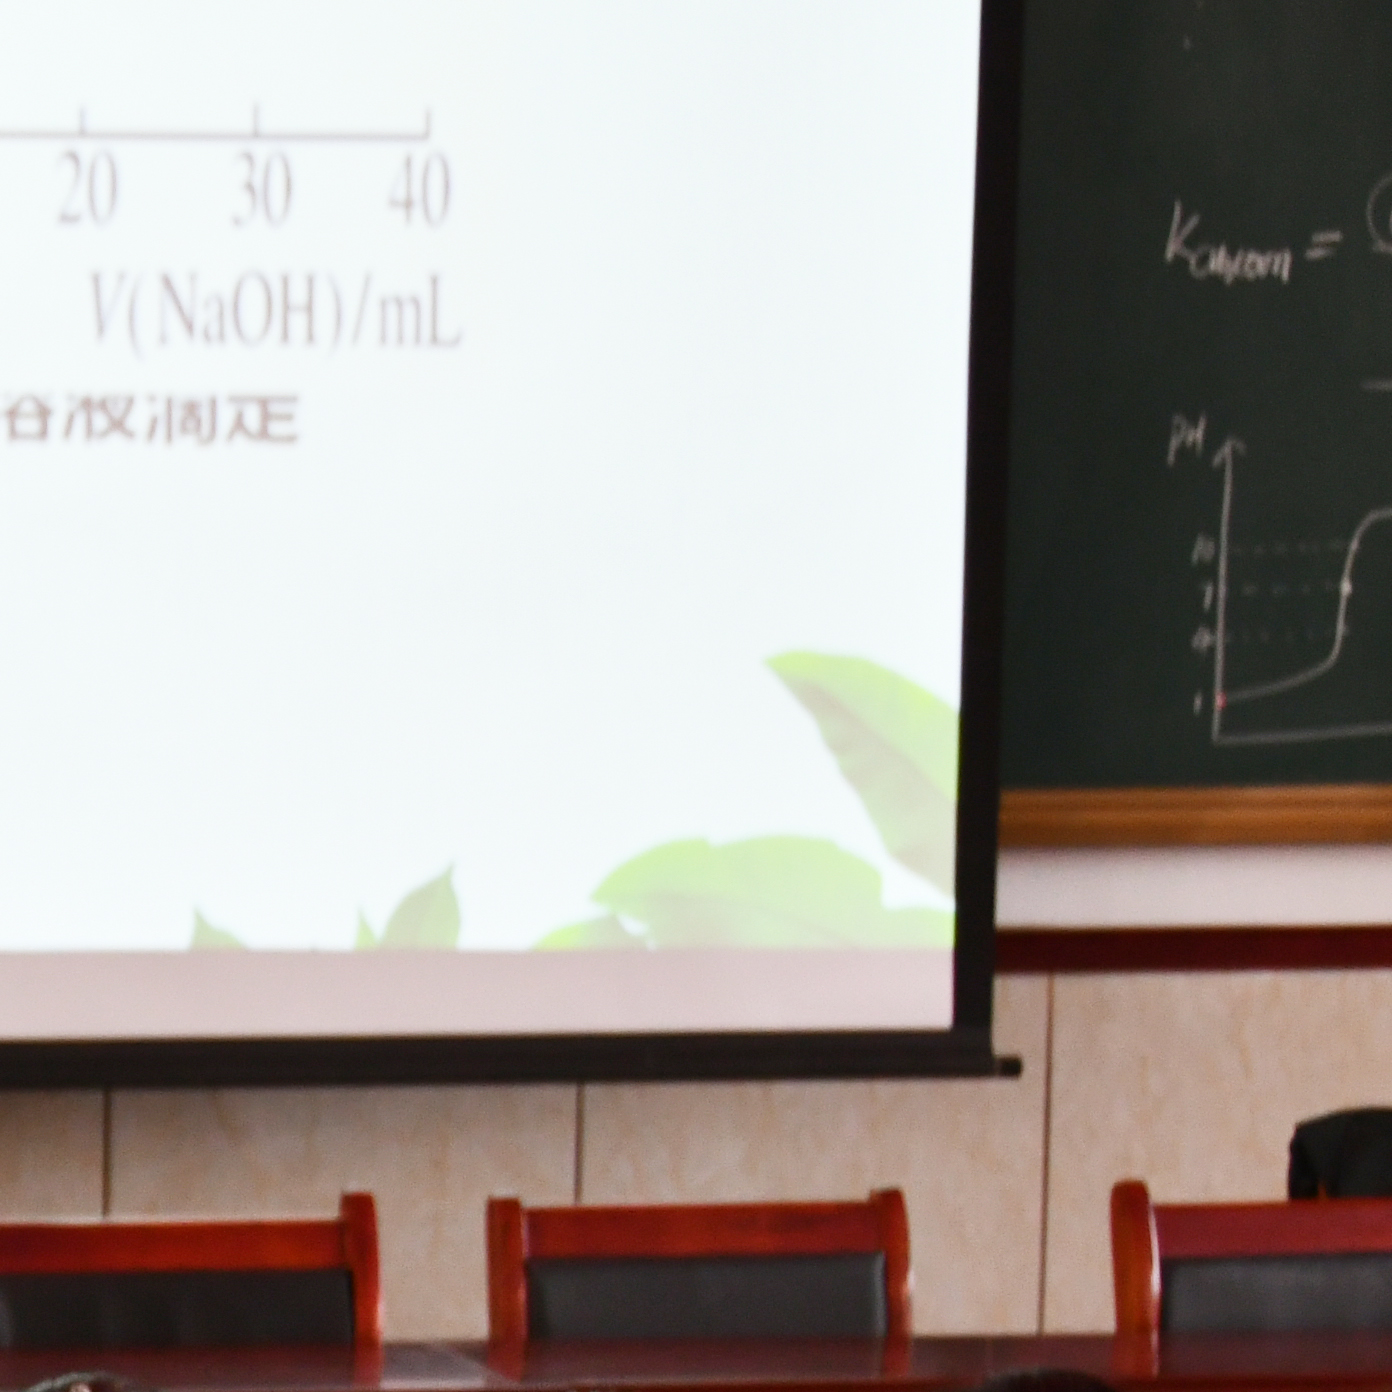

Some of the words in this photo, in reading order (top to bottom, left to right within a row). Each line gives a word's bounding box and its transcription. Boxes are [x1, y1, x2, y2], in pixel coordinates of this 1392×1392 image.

[58, 150, 118, 226] 20
[231, 151, 292, 227] 30
[388, 151, 452, 227] 40
[90, 271, 462, 353] V(NaOH)/mL
